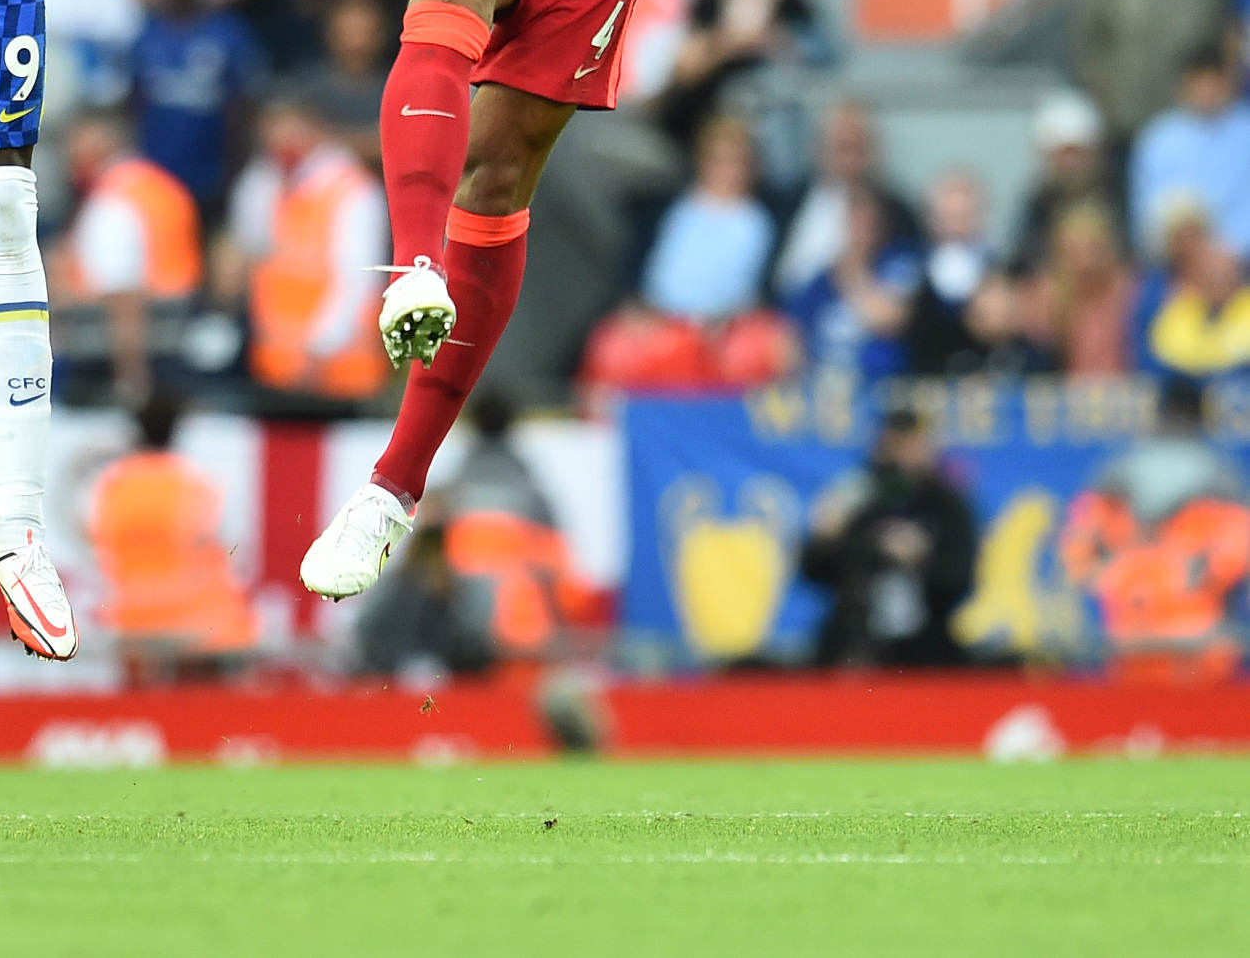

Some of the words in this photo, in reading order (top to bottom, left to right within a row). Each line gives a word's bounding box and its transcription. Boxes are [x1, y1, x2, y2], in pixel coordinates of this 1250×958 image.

[590, 0, 625, 60] 4
[4, 34, 40, 102] 9
[7, 377, 46, 390] CFC
